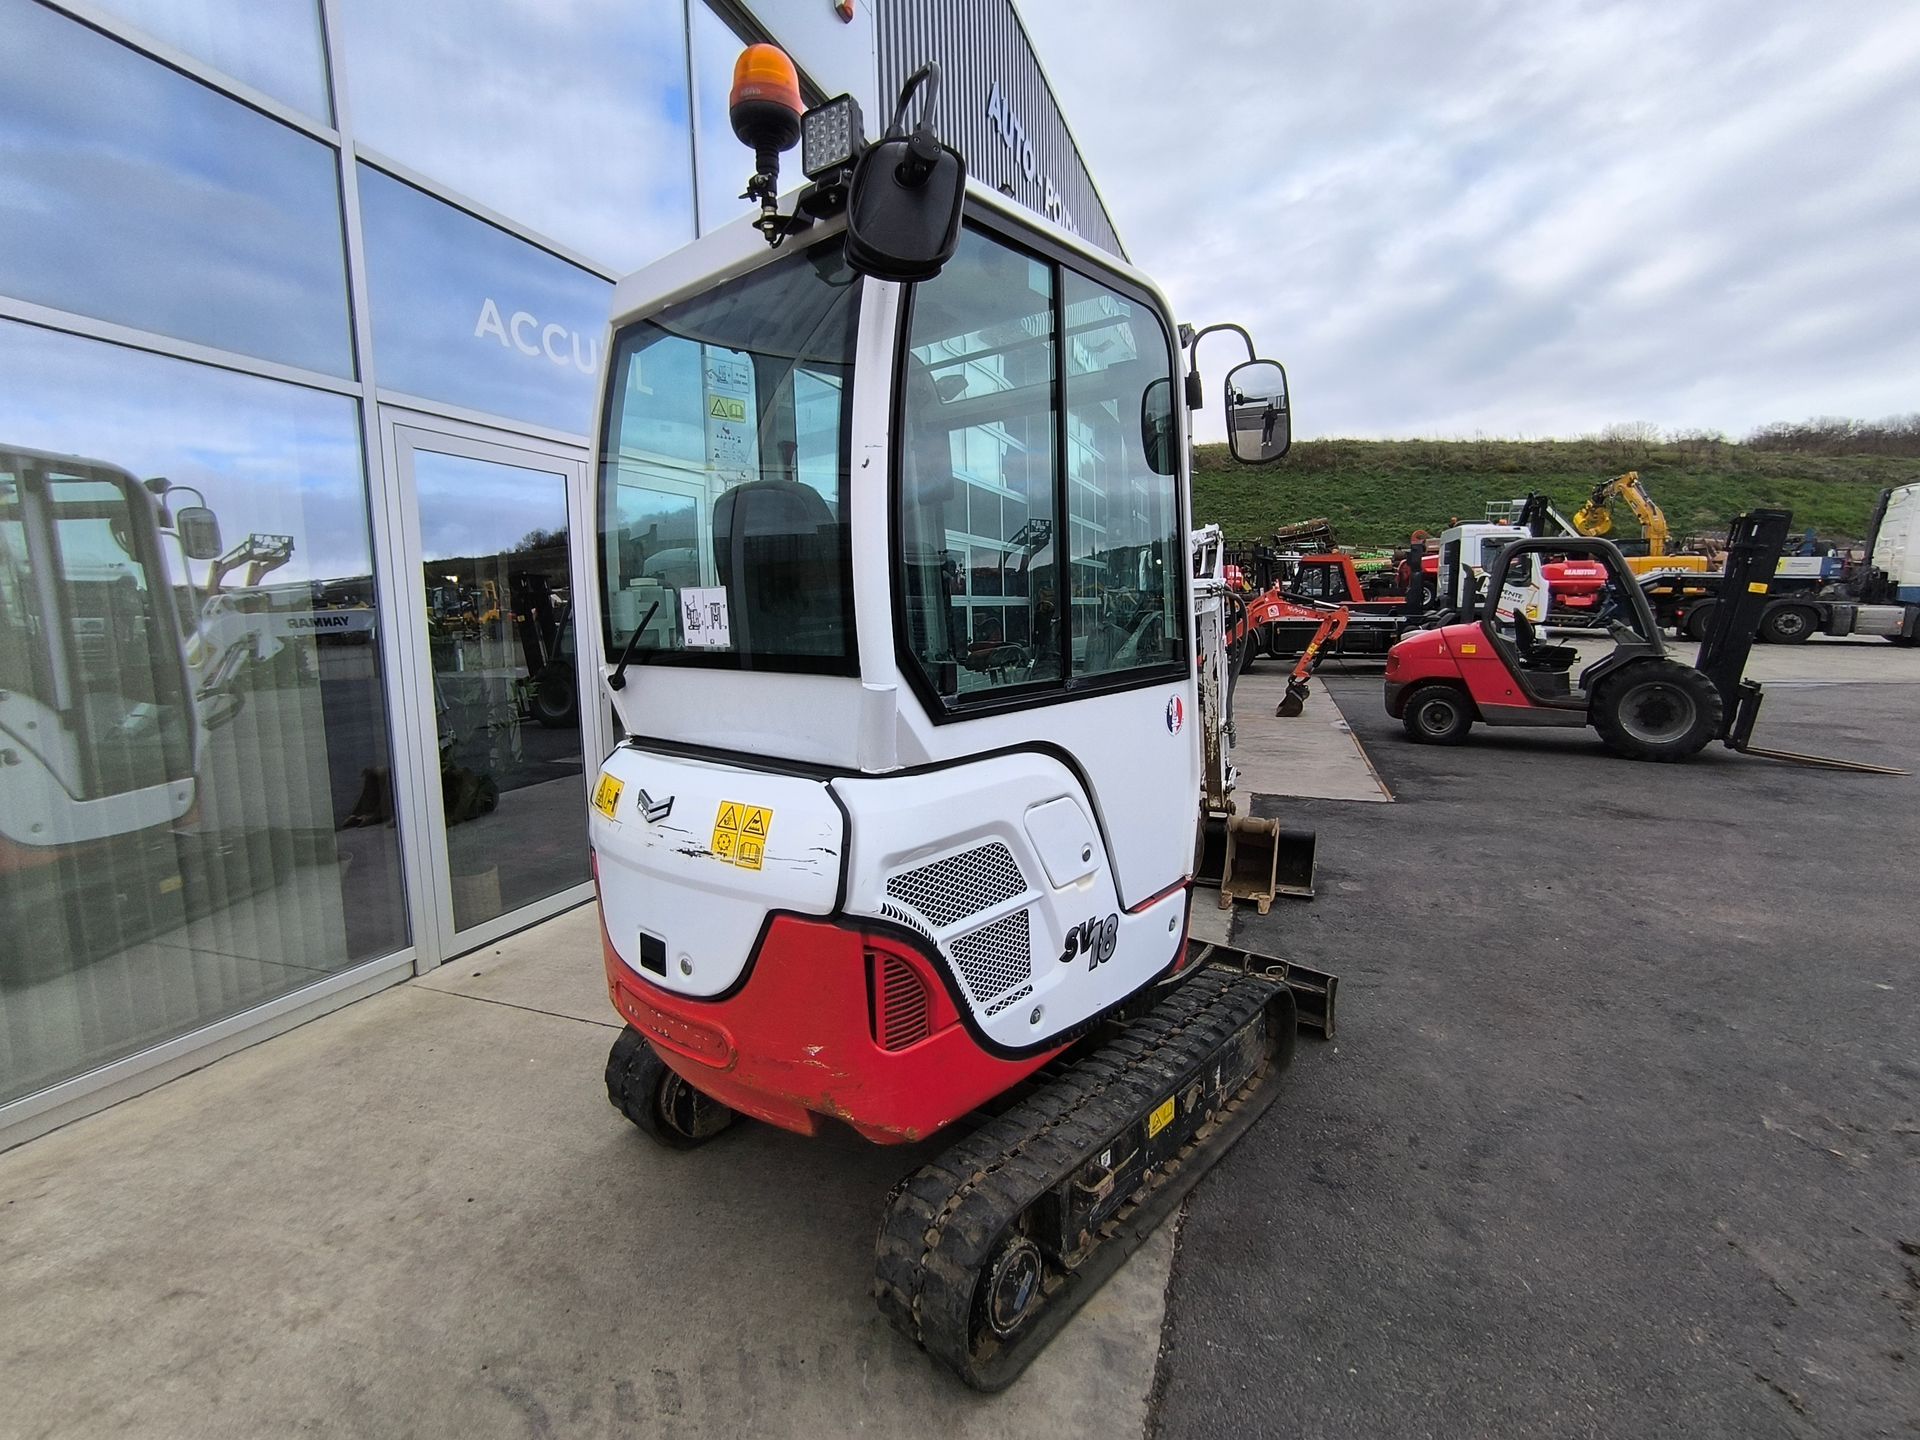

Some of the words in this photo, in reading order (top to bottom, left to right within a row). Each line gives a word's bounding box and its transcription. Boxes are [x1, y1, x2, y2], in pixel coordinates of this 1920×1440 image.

[987, 80, 1034, 182] AUTO
[475, 298, 654, 395] ACCUL
[1059, 912, 1119, 972] SV18
